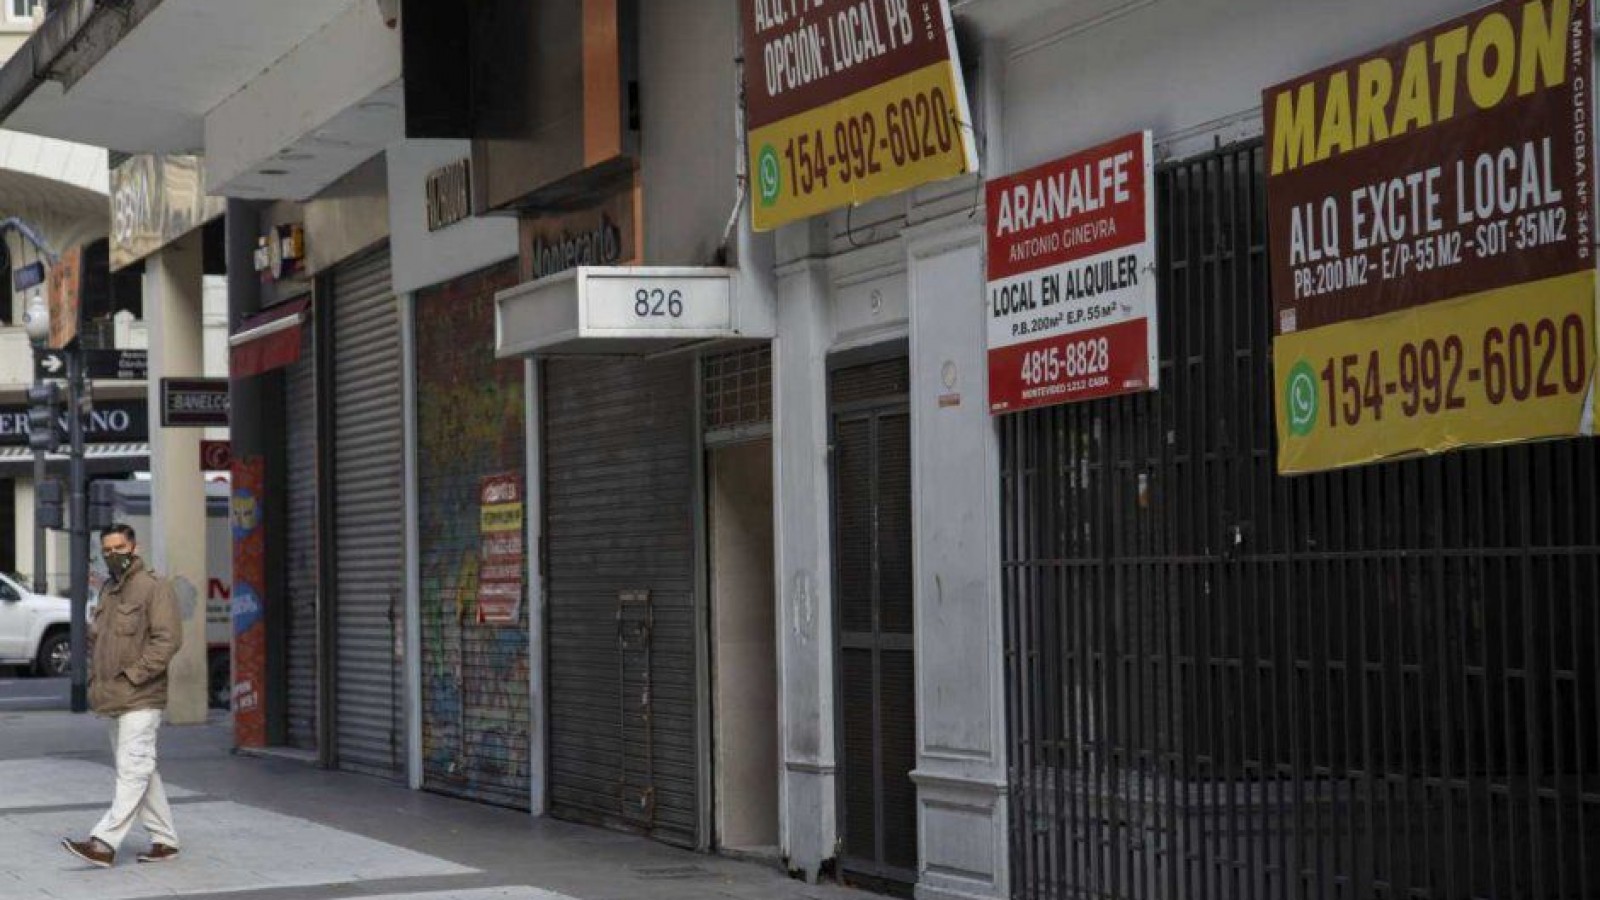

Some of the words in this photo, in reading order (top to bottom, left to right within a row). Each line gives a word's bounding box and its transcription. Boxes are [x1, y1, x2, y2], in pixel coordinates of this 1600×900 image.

[764, 17, 830, 97] OPCIÓN:
[828, 0, 886, 71] LOCAL
[884, 0, 913, 49] PB
[1271, 0, 1570, 176] MARATON
[785, 87, 951, 197] 154-992-6020
[1009, 232, 1060, 263] ANTONIO
[1063, 217, 1117, 250] GINEVRA
[1290, 197, 1340, 266] ALQ
[1352, 166, 1443, 251] EXCTE
[1456, 137, 1562, 225] LOCAL
[634, 289, 683, 317] 826
[993, 279, 1036, 318] LOCAL
[1041, 272, 1060, 306] EN
[1065, 254, 1138, 301] ALQUILER
[1021, 336, 1109, 385] 4815-8828
[1321, 312, 1585, 427] 154-992-6020
